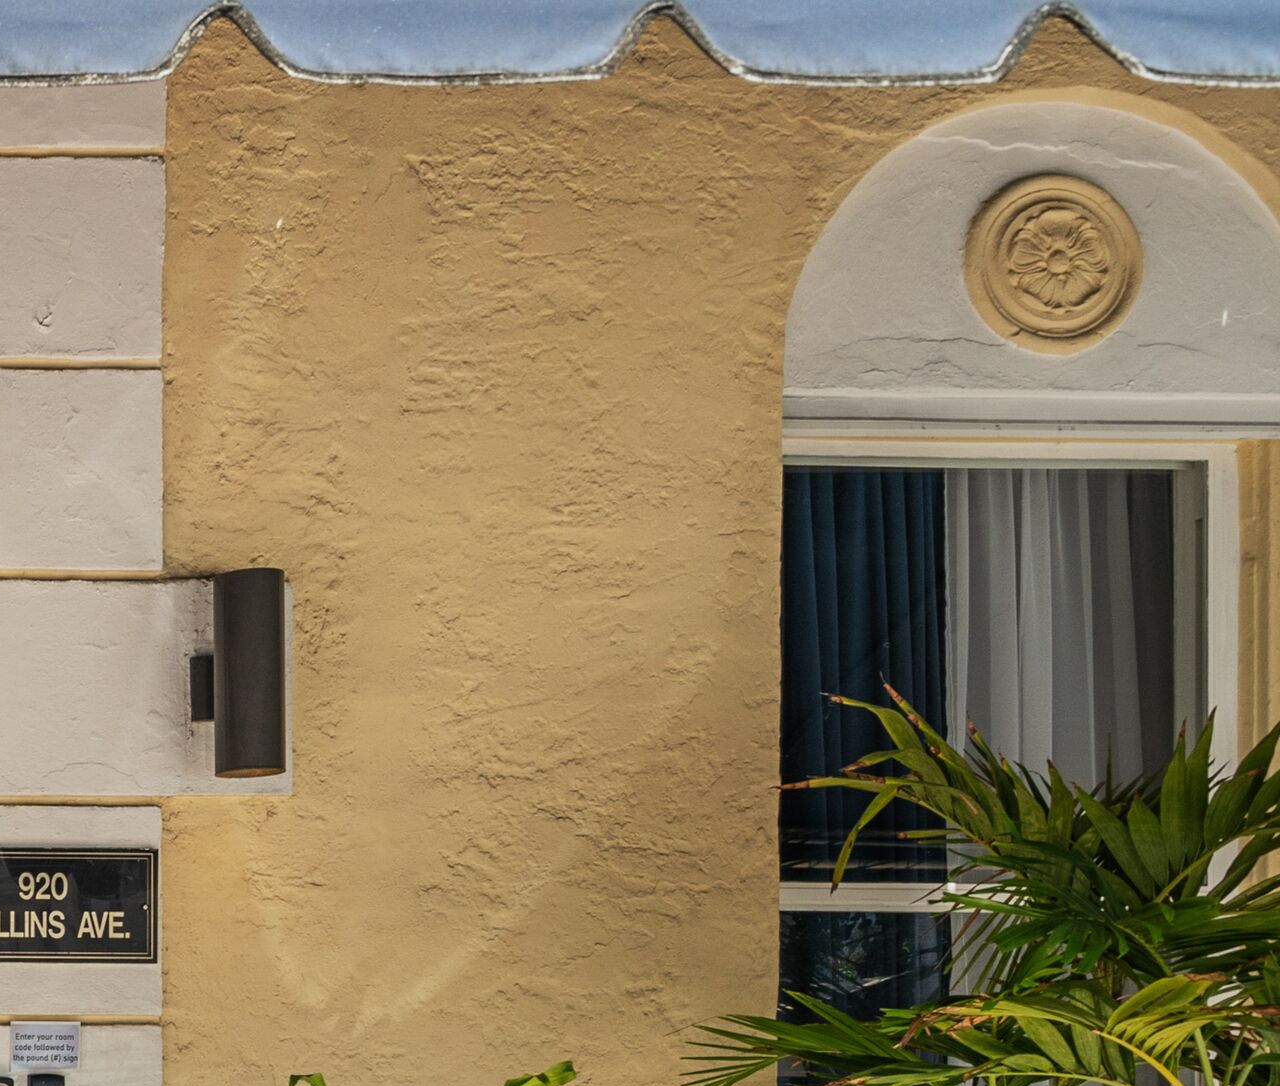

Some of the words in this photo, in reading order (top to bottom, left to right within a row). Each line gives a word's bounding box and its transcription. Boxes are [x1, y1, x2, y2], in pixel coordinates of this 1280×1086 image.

[17, 871, 69, 901] 920
[76, 911, 131, 939] AVE.
[15, 1032, 36, 1041] Enter
[37, 1034, 53, 1042] your
[14, 1043, 32, 1051] code
[33, 1043, 65, 1051] followed
[66, 1043, 75, 1053] by
[26, 1054, 49, 1063] pound
[50, 1053, 62, 1063] (#)
[63, 1054, 79, 1063] sign
